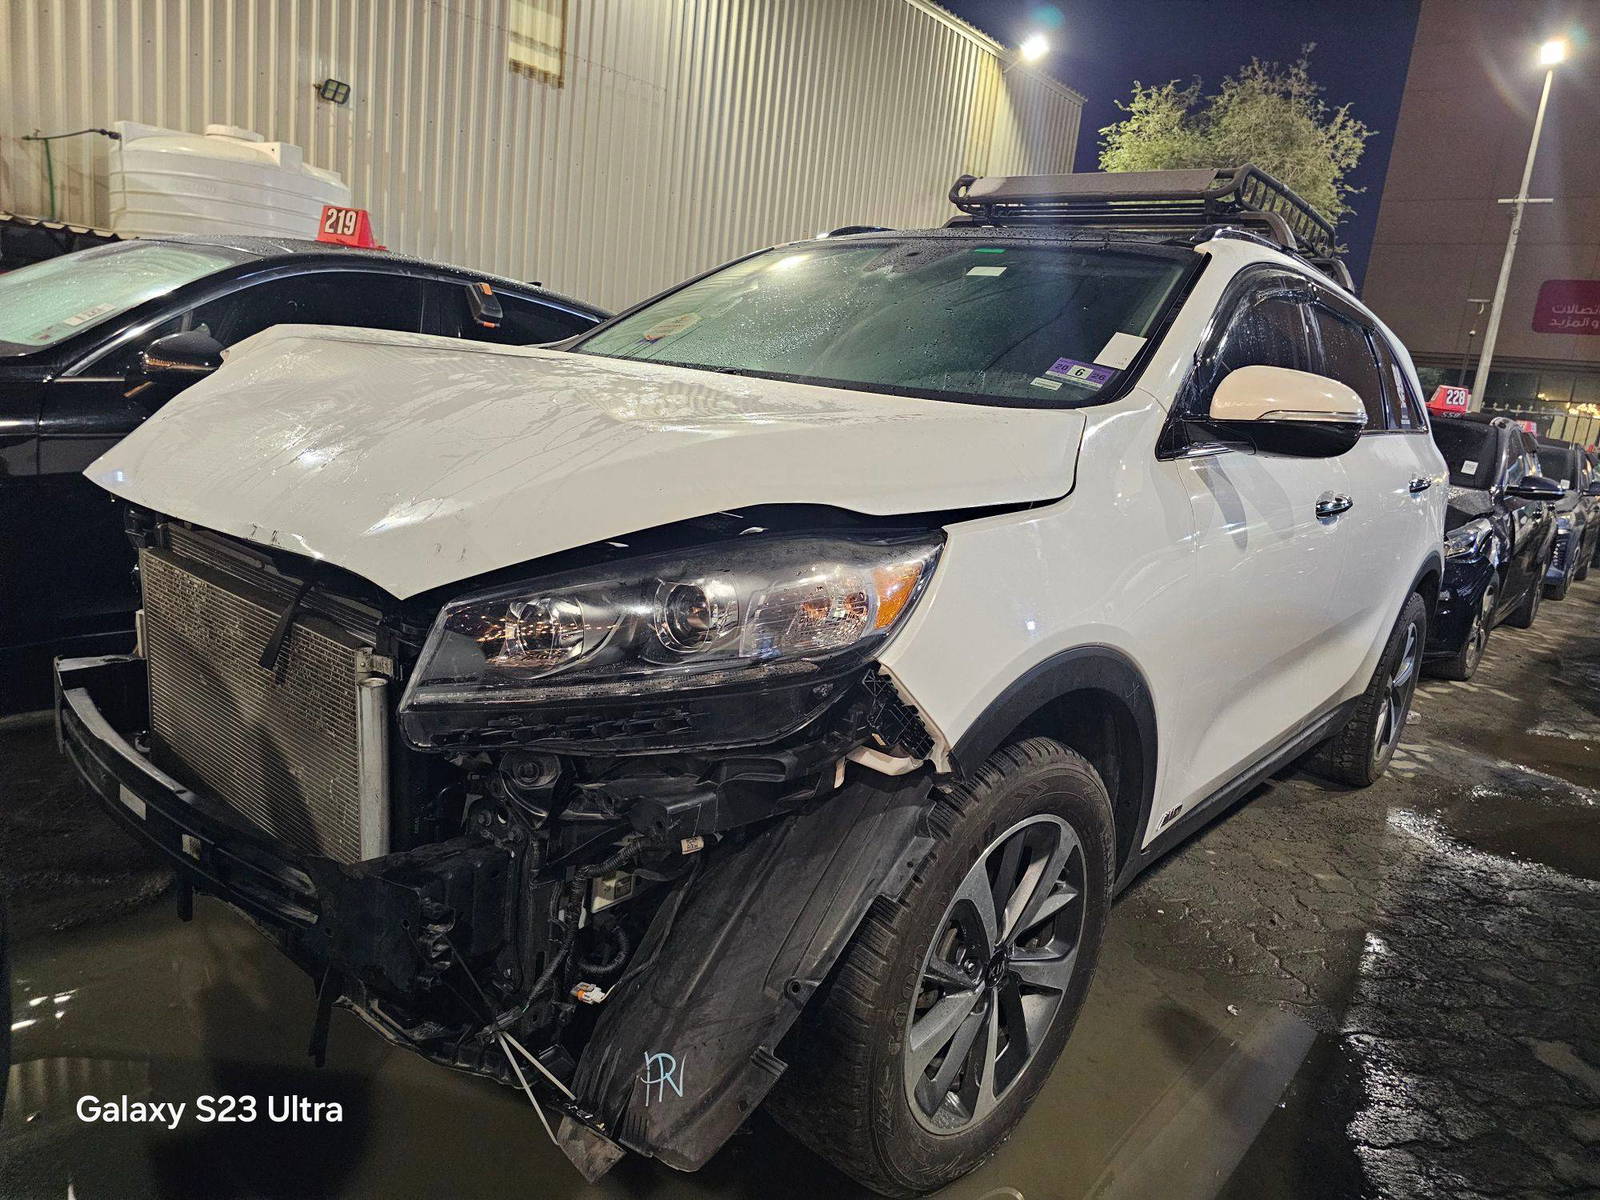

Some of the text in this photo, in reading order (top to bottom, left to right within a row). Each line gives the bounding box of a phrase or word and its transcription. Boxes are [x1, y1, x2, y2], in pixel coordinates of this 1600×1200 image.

[324, 208, 357, 235] 219
[1074, 368, 1086, 377] 6
[1446, 389, 1465, 406] 228
